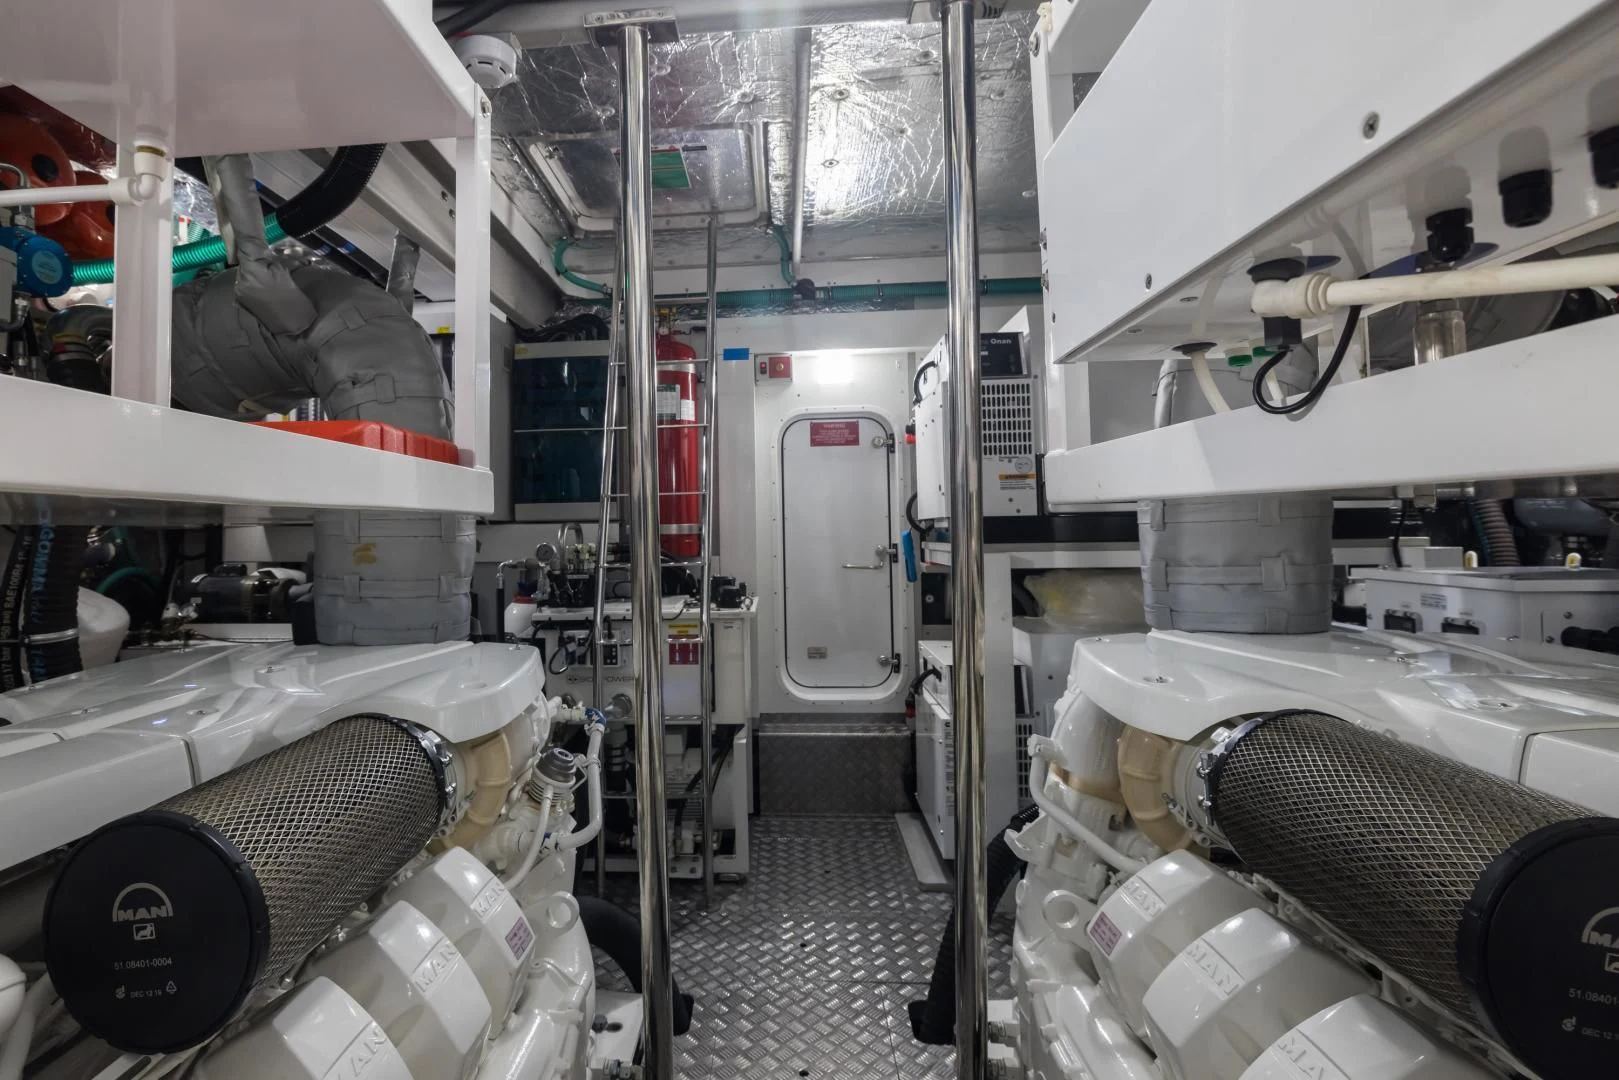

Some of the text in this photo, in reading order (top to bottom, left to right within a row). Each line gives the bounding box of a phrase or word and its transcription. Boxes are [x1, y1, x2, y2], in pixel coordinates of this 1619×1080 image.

[117, 905, 168, 921] MAN
[479, 882, 506, 914] MAN
[1125, 880, 1162, 917] MAN
[414, 943, 457, 993] MAN
[1187, 943, 1240, 996] MAN
[1581, 1027, 1601, 1038] DEC
